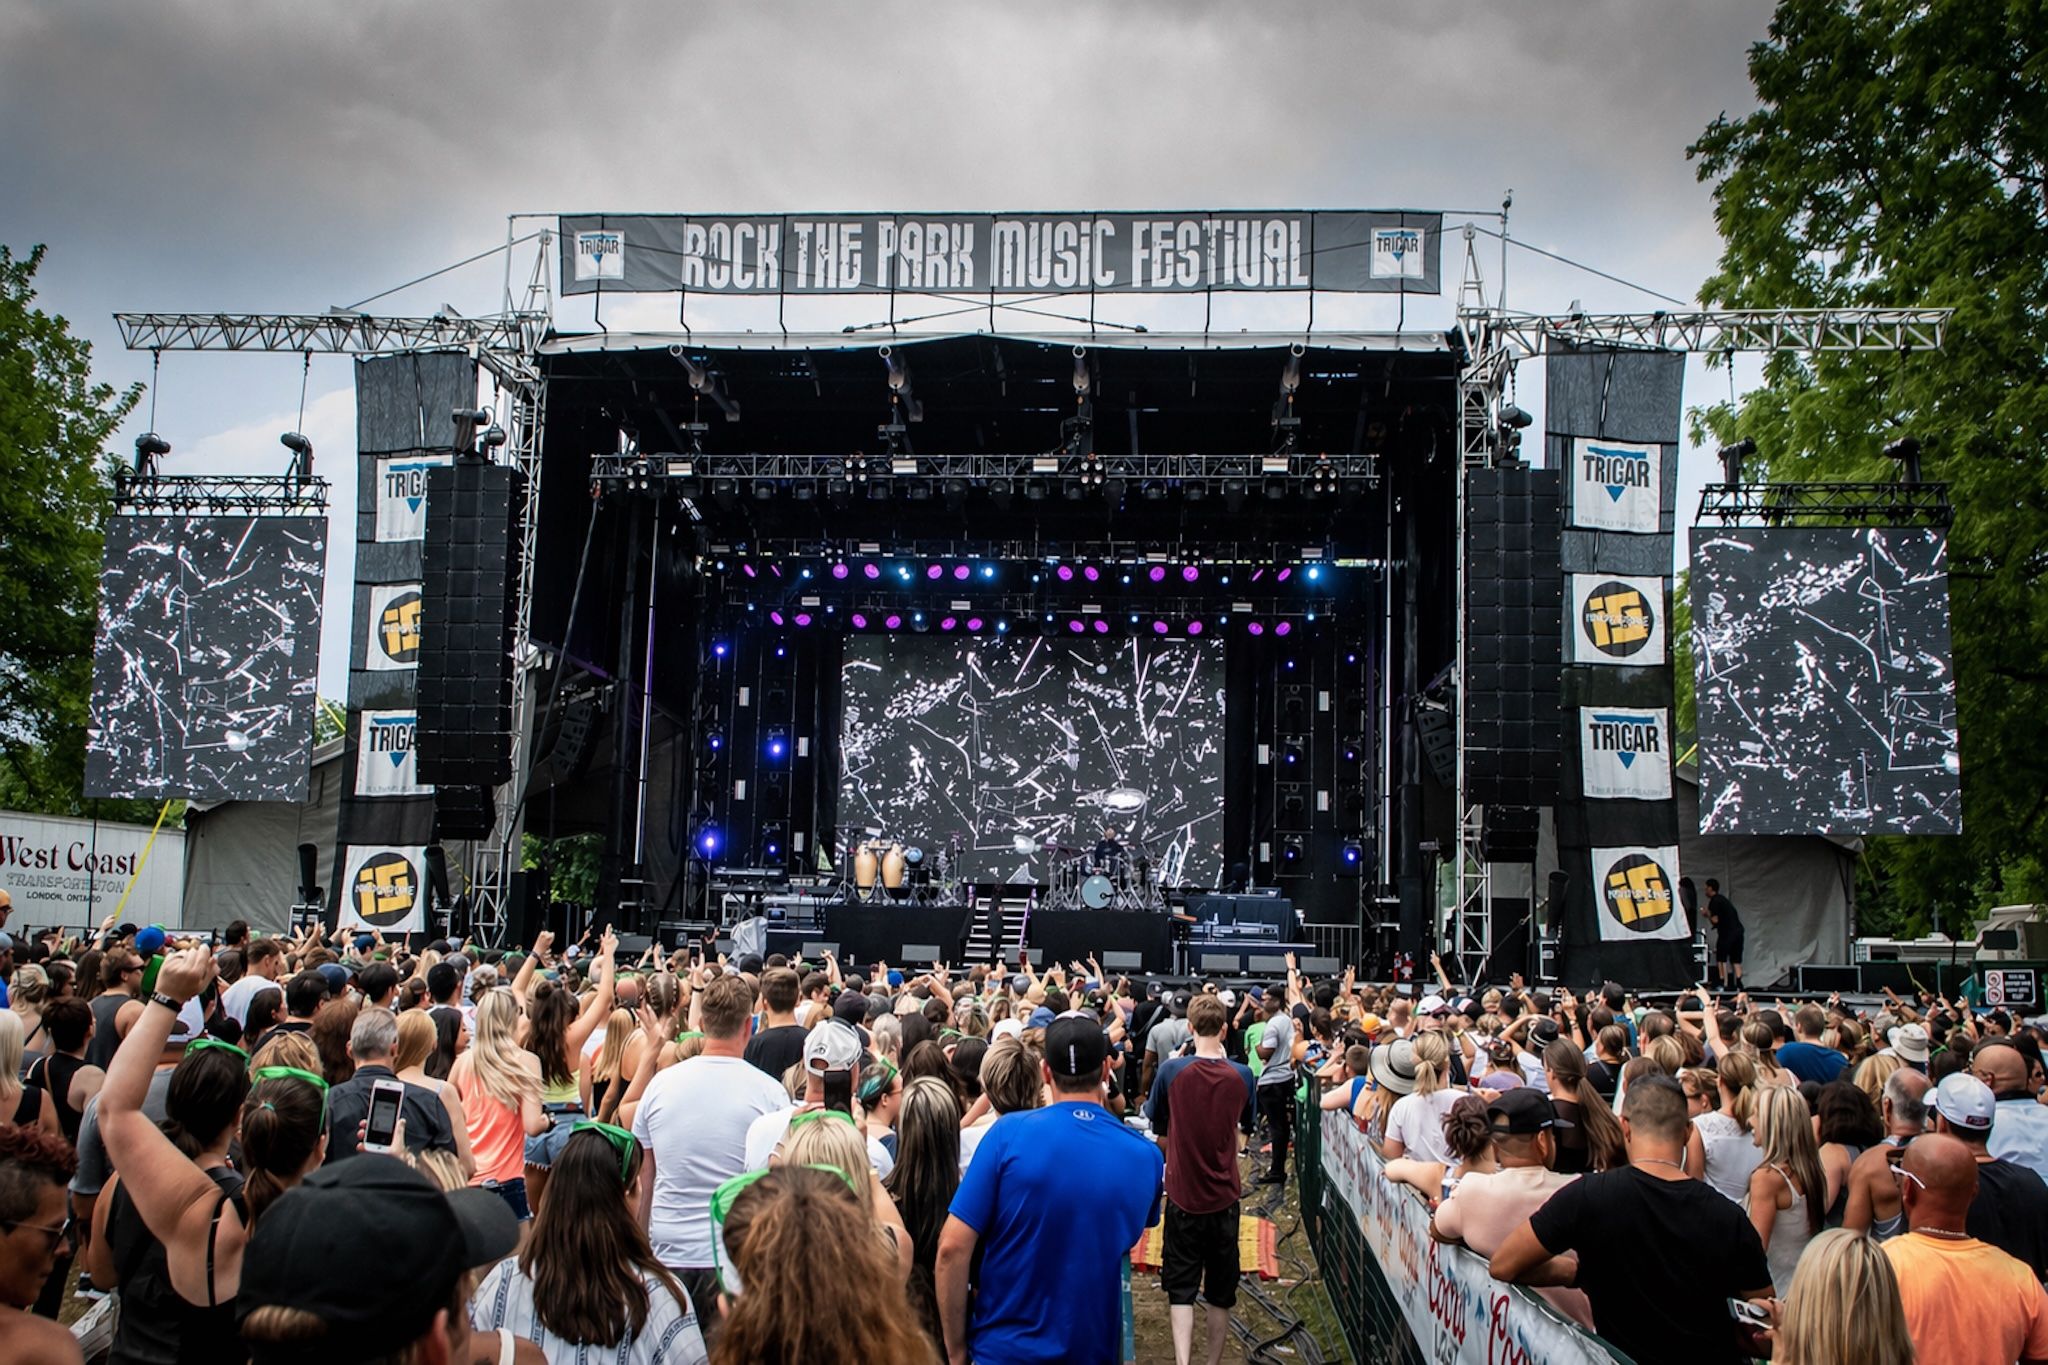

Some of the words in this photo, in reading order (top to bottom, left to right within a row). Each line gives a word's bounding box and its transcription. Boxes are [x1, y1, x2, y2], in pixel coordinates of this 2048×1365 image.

[682, 222, 780, 290] ROCK
[793, 222, 862, 289] THE
[877, 220, 974, 288] PARK
[0, 836, 59, 870] West
[67, 841, 137, 876] Coast
[67, 894, 102, 903] ONTAIO
